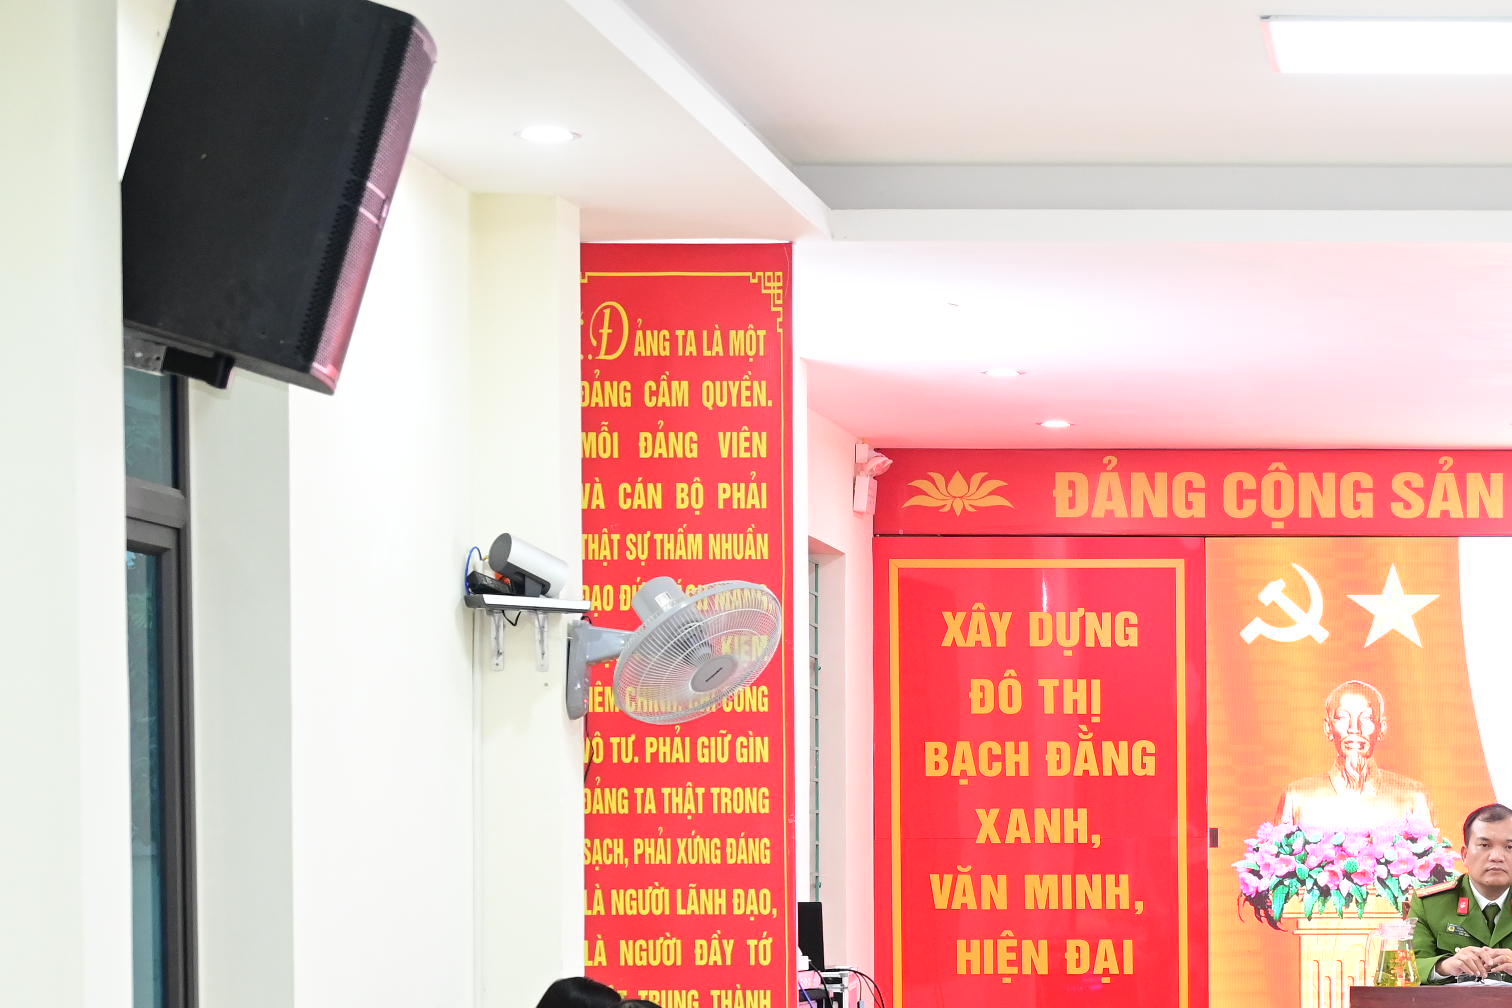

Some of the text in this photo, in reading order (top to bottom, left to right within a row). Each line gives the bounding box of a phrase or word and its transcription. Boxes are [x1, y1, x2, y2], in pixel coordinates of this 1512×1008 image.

[676, 330, 697, 356] TA
[703, 325, 723, 356] LÀ
[730, 325, 766, 360] MỘT
[645, 373, 688, 407] CẦM
[582, 420, 767, 458] MỖI ĐẢNG VIÊN
[619, 478, 662, 509] CÁN
[676, 477, 704, 515] BỘ
[718, 472, 767, 509] PHẢI
[1054, 456, 1205, 518] ĐẢNG
[1224, 463, 1373, 528] CỘNG
[1391, 456, 1503, 519] SẢN
[582, 525, 768, 566] THẬT SỰ THẤM NHUẦN
[943, 603, 1138, 656] XÂY DỰNG
[589, 681, 619, 712] IÊM
[969, 670, 1100, 722] ĐÔ THỊ
[610, 734, 638, 763] TƯ.
[646, 725, 690, 763] PHẢI
[697, 730, 732, 763] GIỮ
[736, 731, 769, 763] GÌN
[925, 725, 1155, 785] BẠCH ĐẰNG
[634, 788, 656, 813] TA
[661, 782, 705, 819] THẬT
[710, 787, 769, 814] TRONG
[634, 828, 671, 864] PHẢI
[677, 831, 721, 864] XỨNG
[726, 832, 771, 864] ĐÁNG
[976, 808, 1100, 848] XANH,
[584, 882, 777, 920] LÀ NGƯỜI LÃNH ĐẠO,
[930, 866, 1143, 914] VĂN MINH,
[584, 931, 773, 966] LÀ NGƯỜI ĐẦY TỚ
[957, 930, 1133, 983] HIỆN ĐẠI
